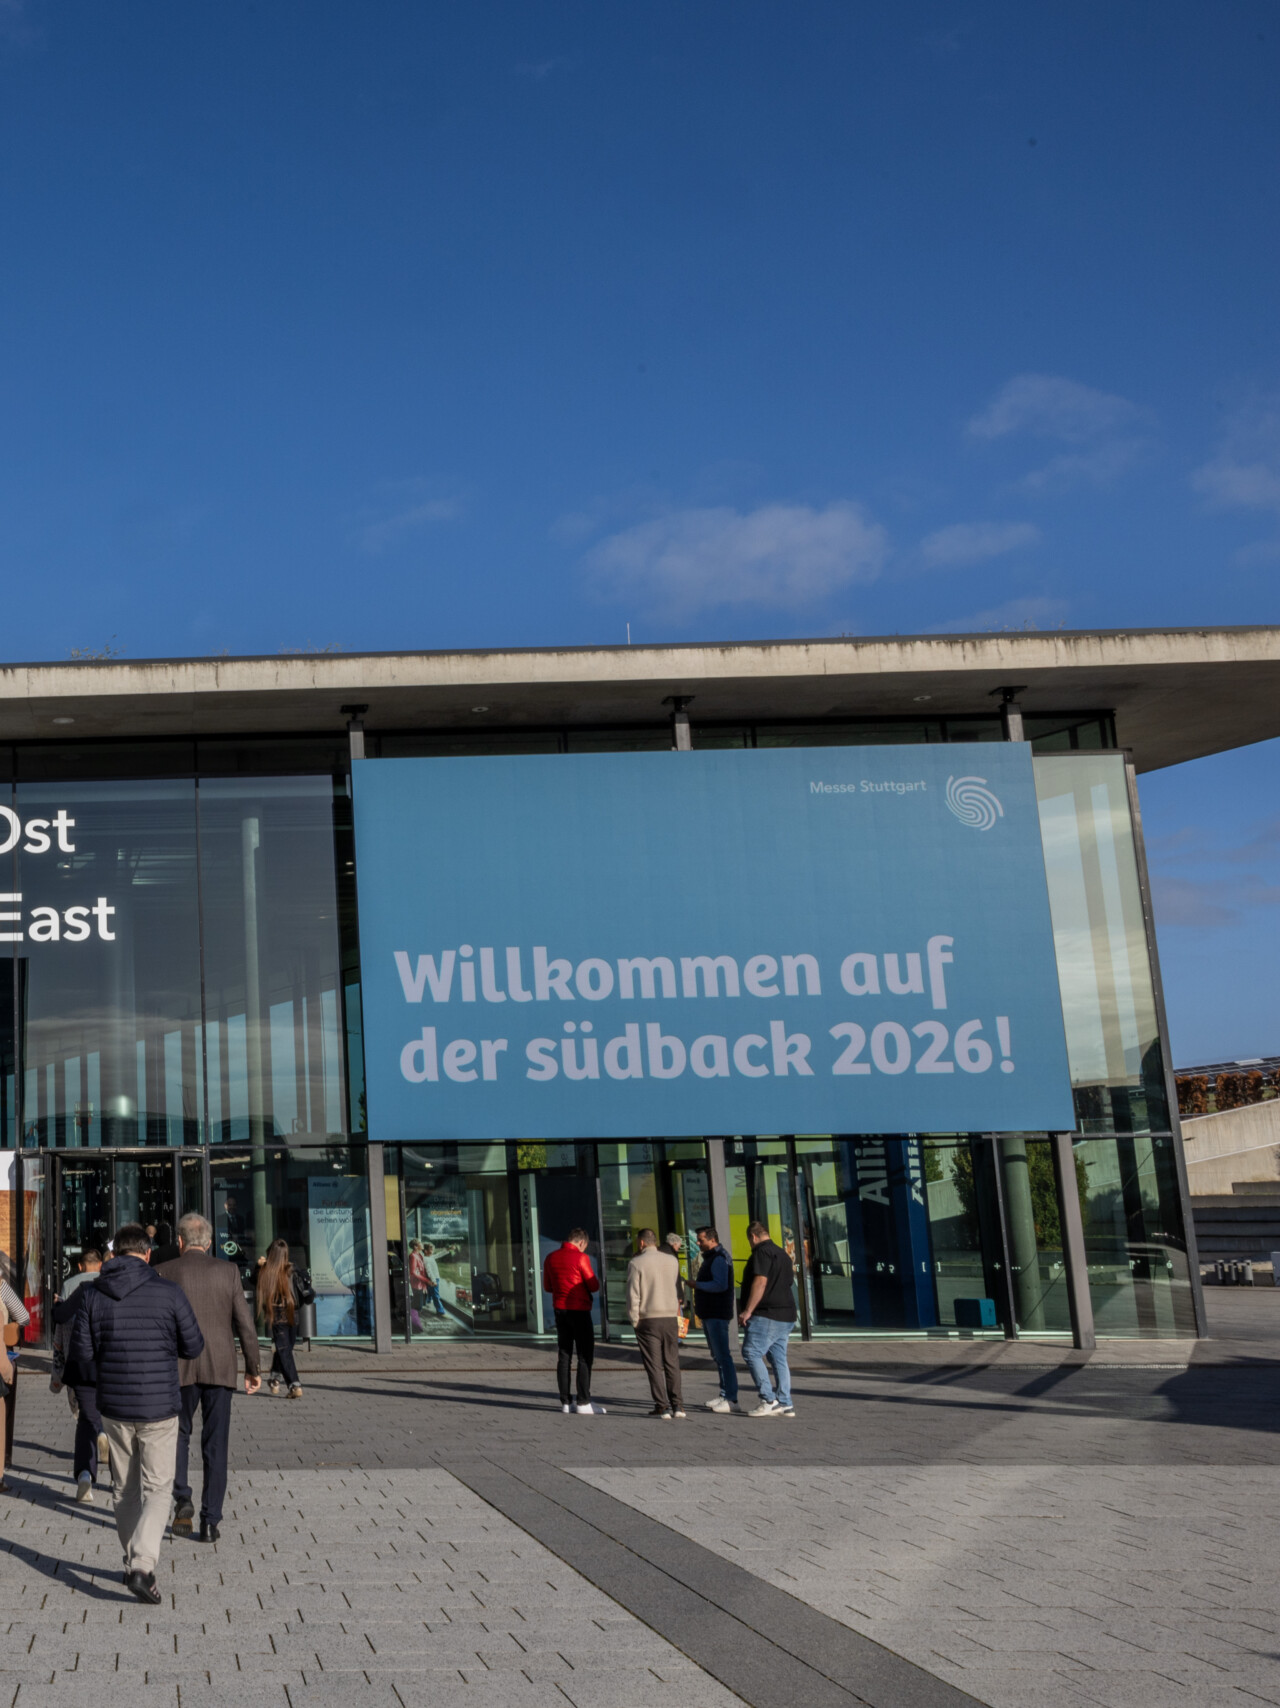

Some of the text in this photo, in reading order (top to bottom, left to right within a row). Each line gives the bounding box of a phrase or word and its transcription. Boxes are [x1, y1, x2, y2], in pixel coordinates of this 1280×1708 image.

[810, 780, 927, 795] Messe Stuttgart
[393, 934, 955, 1012] Willkommen auf
[399, 1015, 1017, 1085] der südback 2026!
[325, 1208, 354, 1217] Leistung
